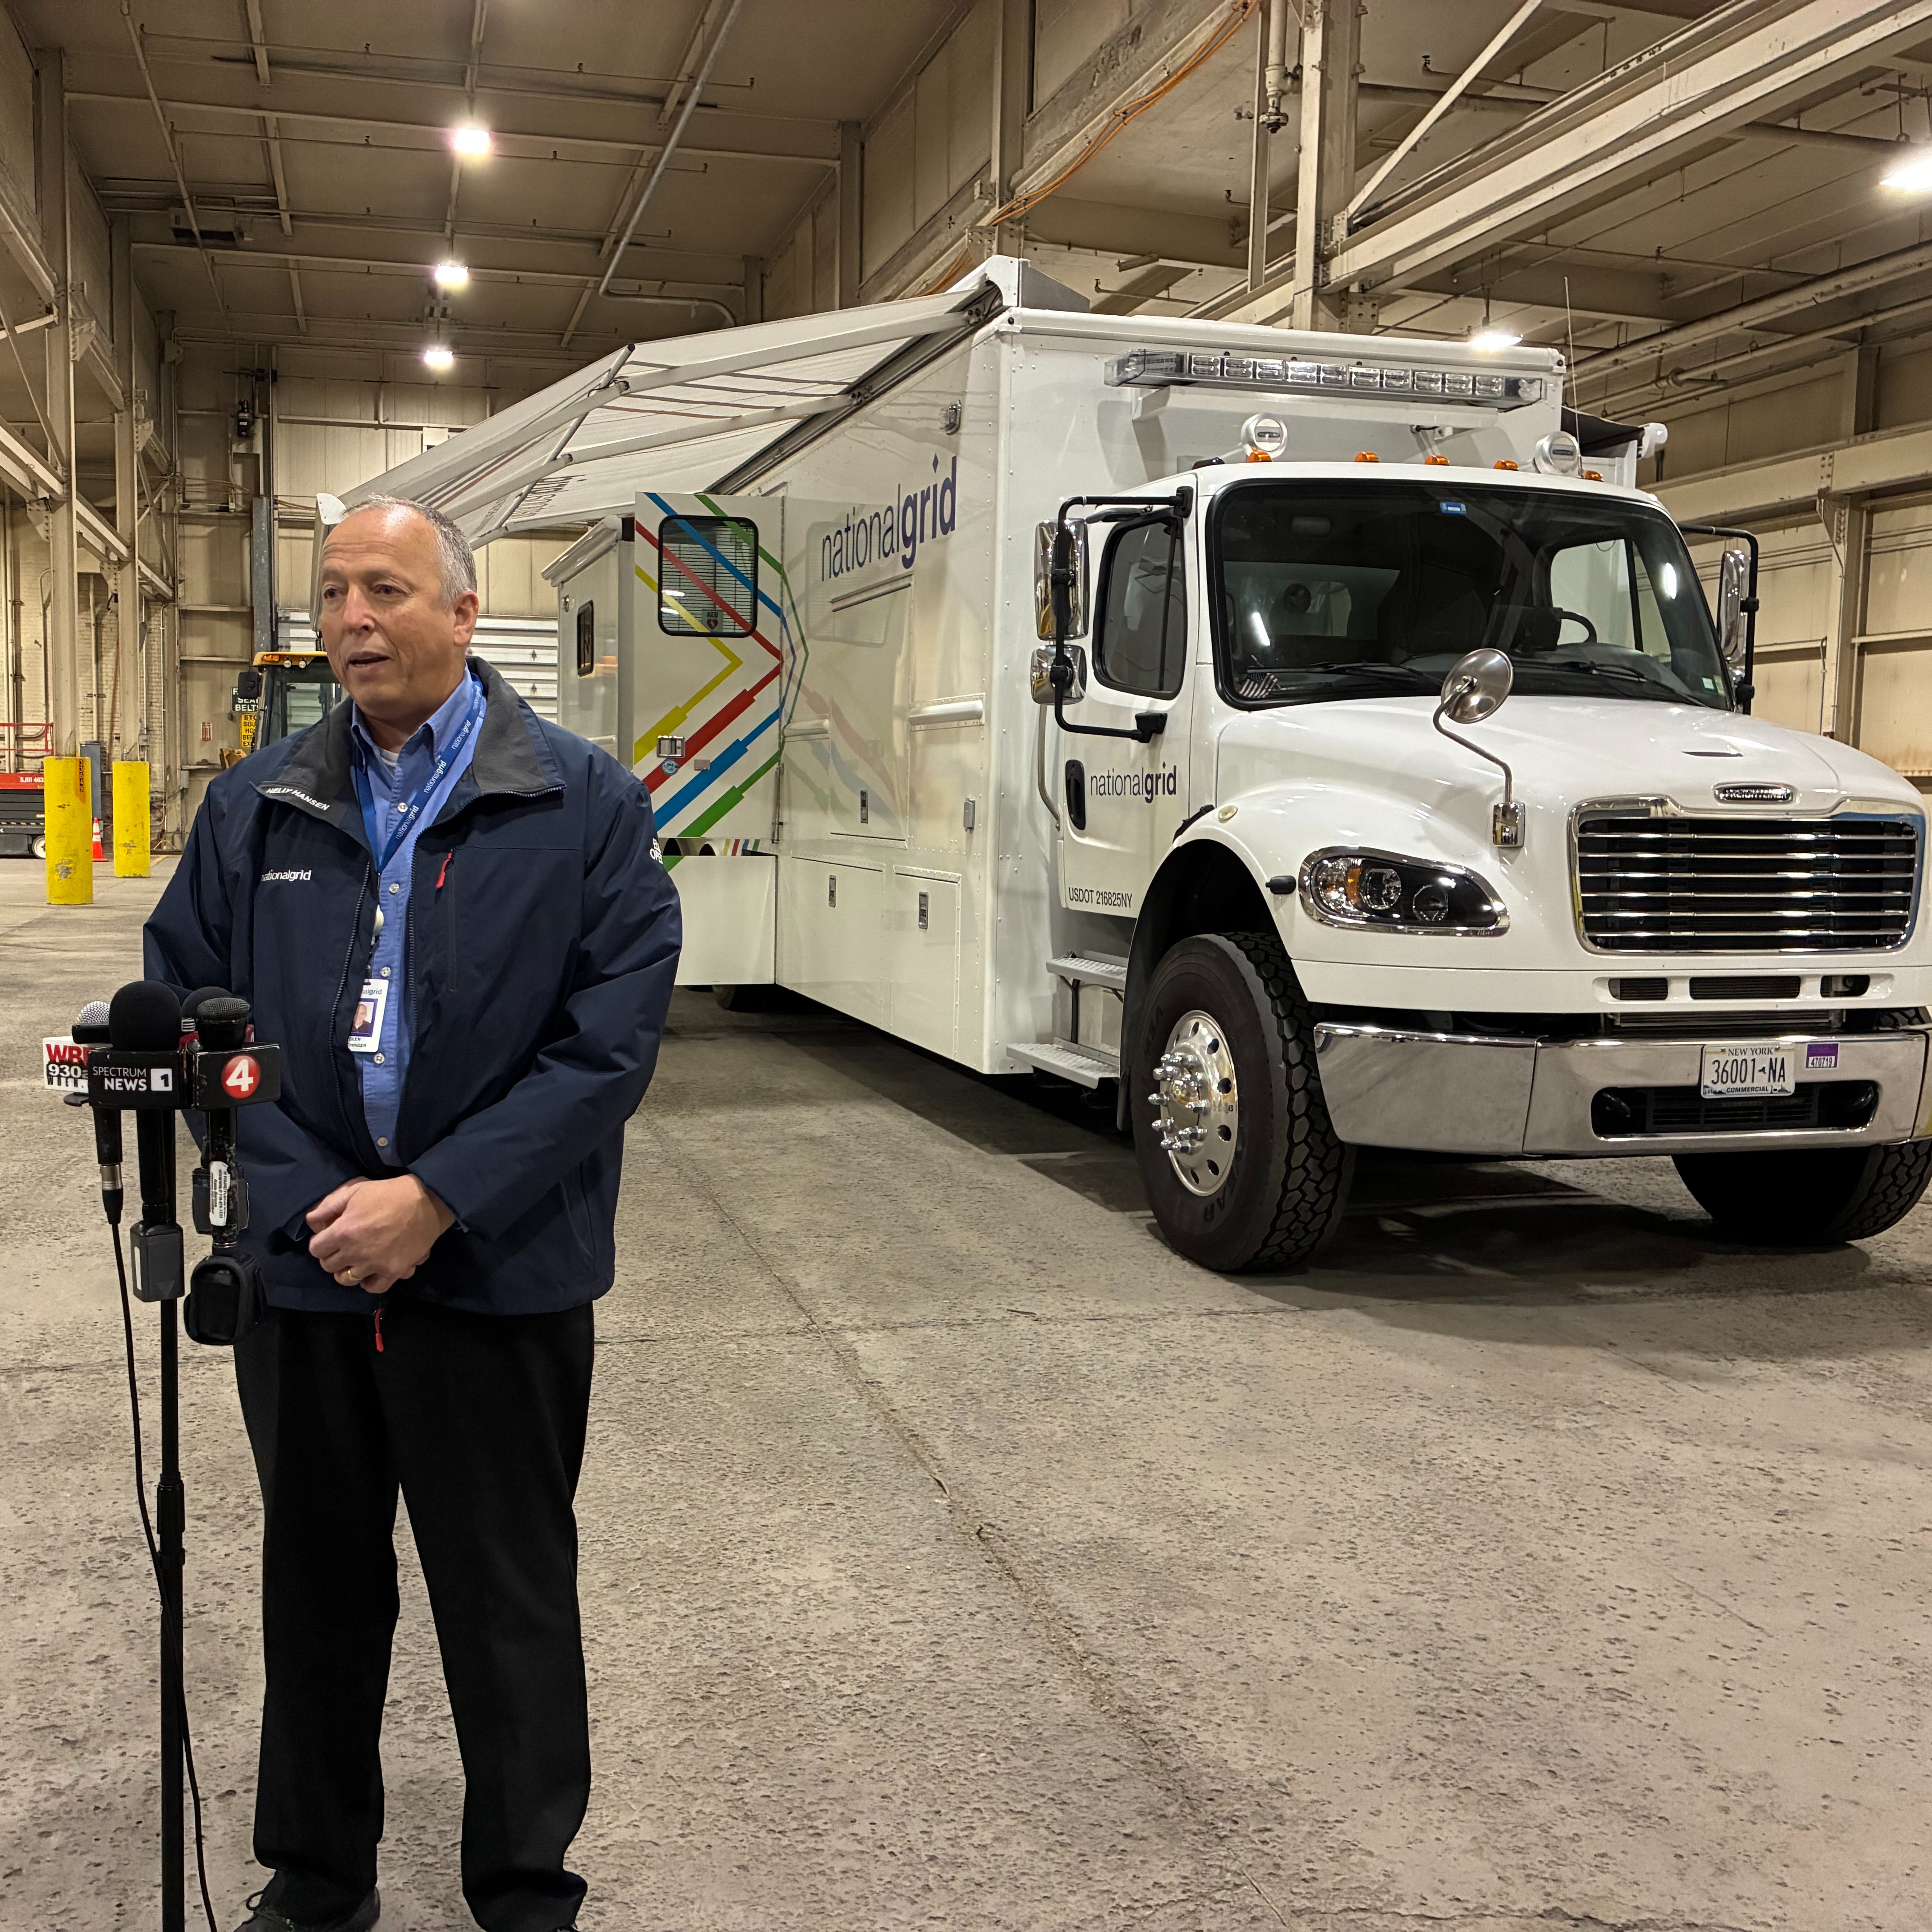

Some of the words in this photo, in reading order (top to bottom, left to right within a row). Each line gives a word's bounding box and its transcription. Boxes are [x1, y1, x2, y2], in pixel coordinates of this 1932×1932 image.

[822, 453, 957, 582] nationalgrid
[451, 720, 471, 750] nationalgrid
[424, 760, 446, 793] nationalgrid
[1090, 761, 1177, 804] nationalgrid
[292, 790, 330, 810] HANSEN
[396, 805, 419, 840] nationalgrid
[261, 869, 312, 882] nationalgrid
[1069, 887, 1094, 903] USDOT
[1096, 890, 1132, 908] 216825NY
[46, 1044, 89, 1063] WB
[1728, 1048, 1748, 1056] NEW
[1751, 1046, 1773, 1055] YORK
[48, 1063, 88, 1079] 930a
[92, 1066, 146, 1077] SPECTRUM
[161, 1074, 169, 1087] 1
[226, 1059, 253, 1091] 4
[1711, 1058, 1756, 1084] 36001
[1768, 1057, 1786, 1083] NA
[105, 1077, 147, 1091] NEWS
